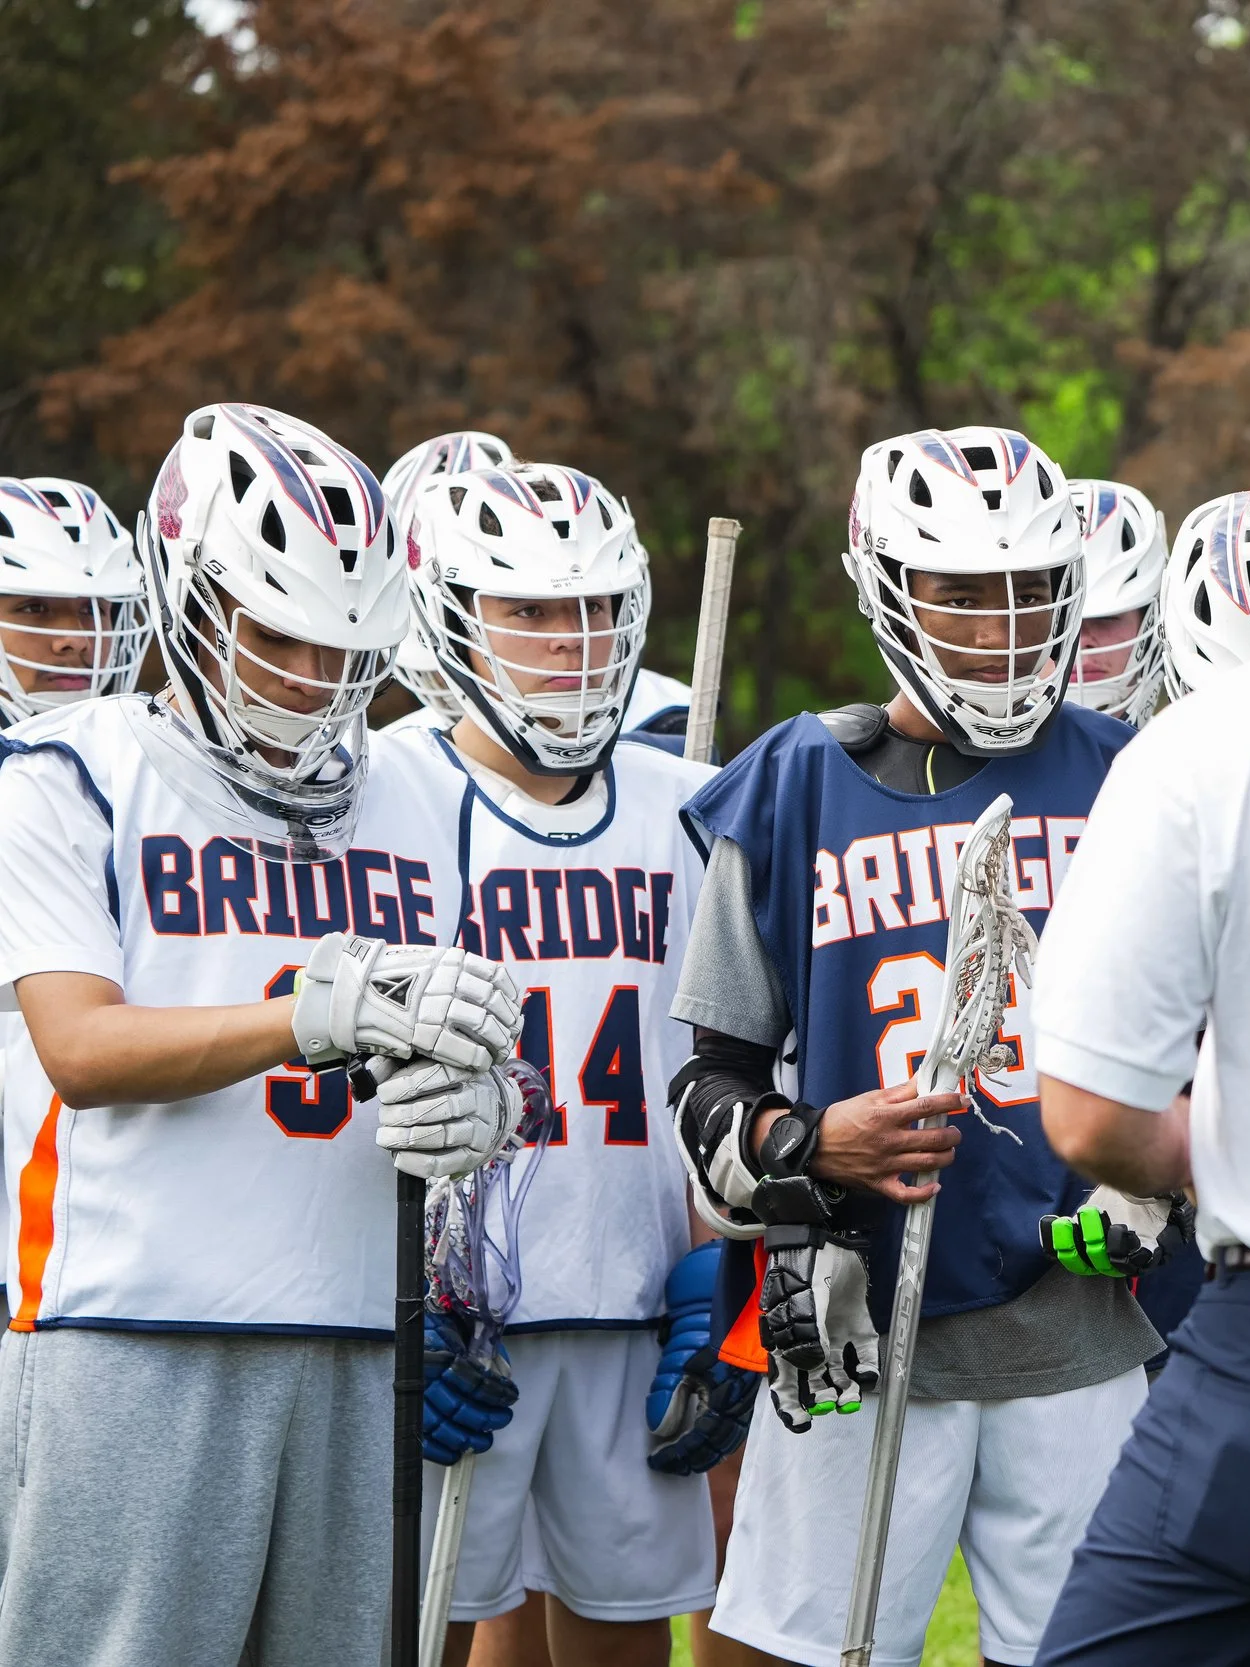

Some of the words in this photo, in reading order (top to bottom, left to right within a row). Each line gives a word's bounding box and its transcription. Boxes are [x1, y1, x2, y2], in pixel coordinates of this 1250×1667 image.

[983, 736, 1026, 745] cascade
[141, 833, 437, 945] BRIDGE
[516, 984, 649, 1146] 14
